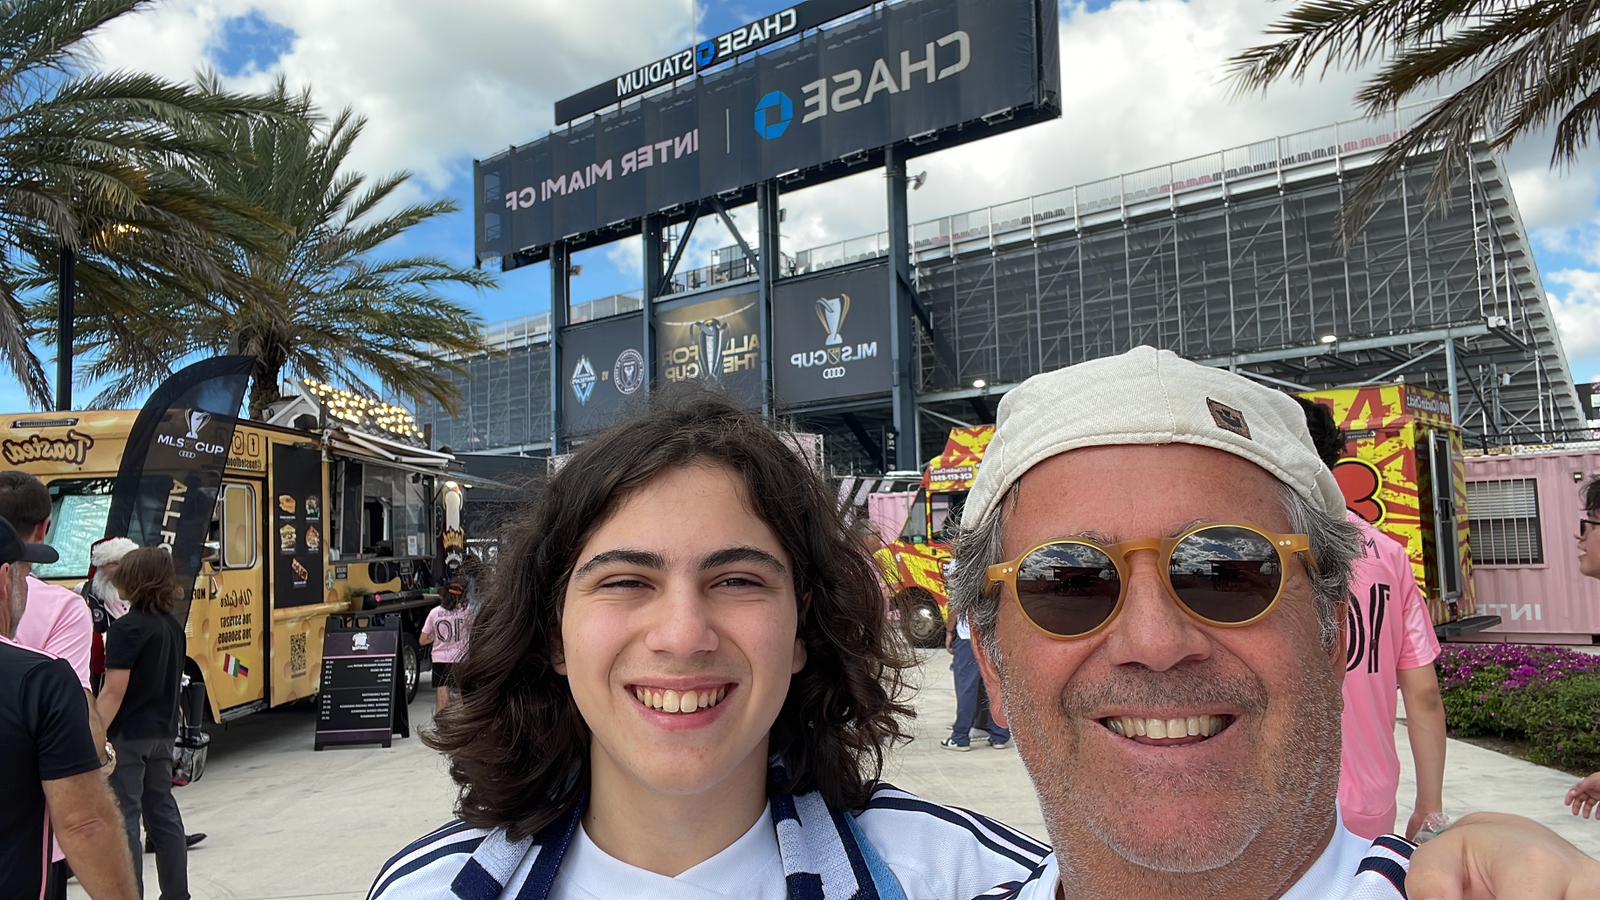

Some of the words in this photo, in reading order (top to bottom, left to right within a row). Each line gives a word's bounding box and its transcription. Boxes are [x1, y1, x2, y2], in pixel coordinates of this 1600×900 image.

[157, 434, 185, 447] MLS
[195, 441, 224, 455] CUP
[162, 479, 188, 527] ALL
